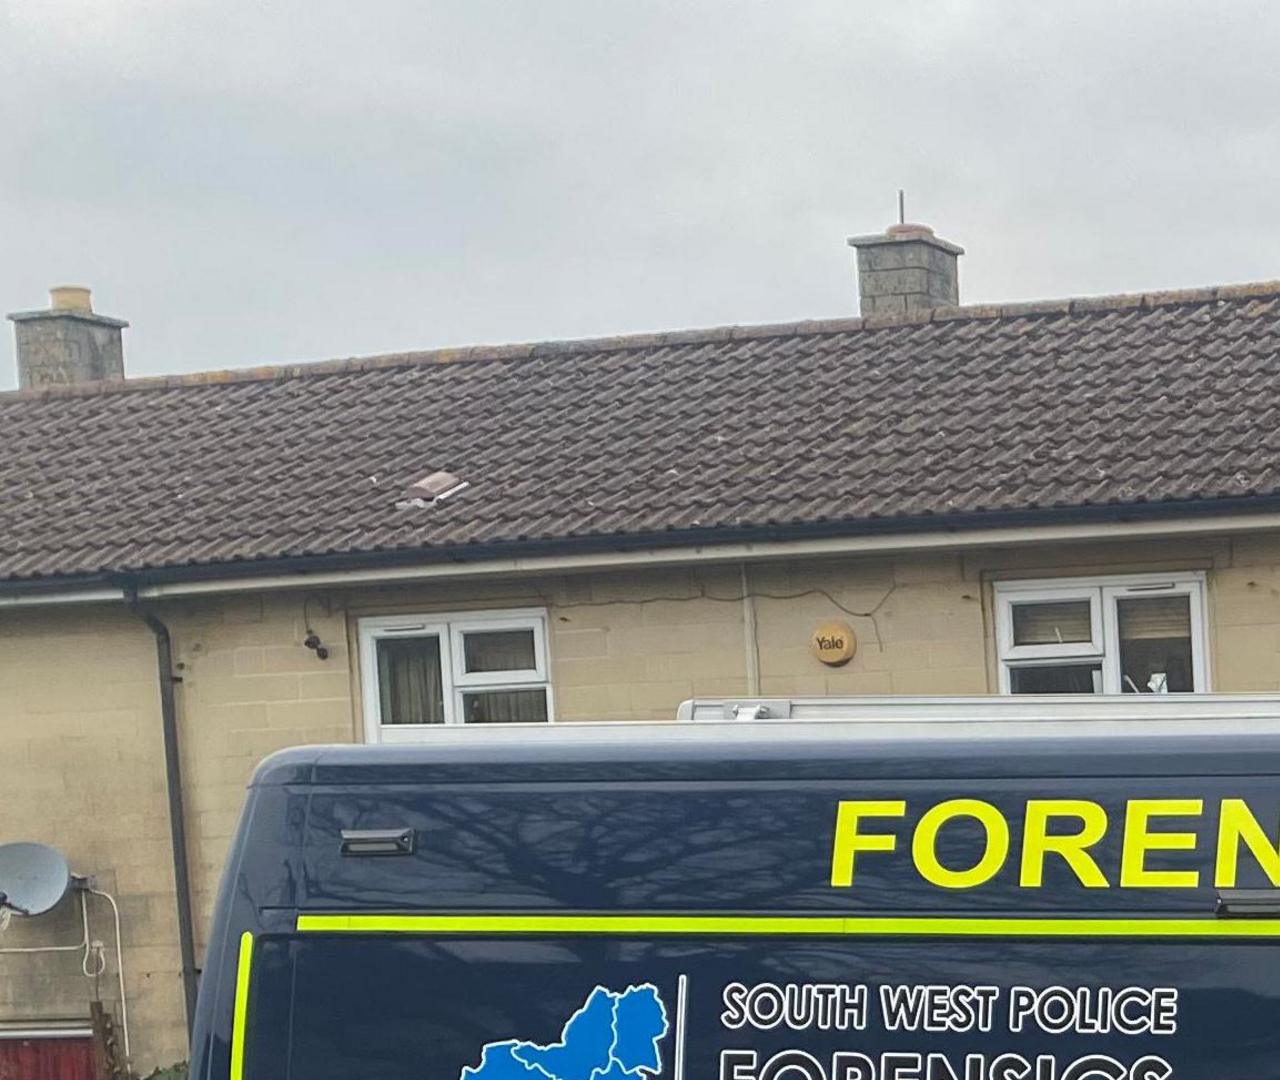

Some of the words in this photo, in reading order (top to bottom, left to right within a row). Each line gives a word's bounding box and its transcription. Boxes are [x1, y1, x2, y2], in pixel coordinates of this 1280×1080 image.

[721, 982, 867, 1030] SOUTH
[880, 984, 999, 1032] WEST
[1009, 986, 1178, 1035] POLICE
